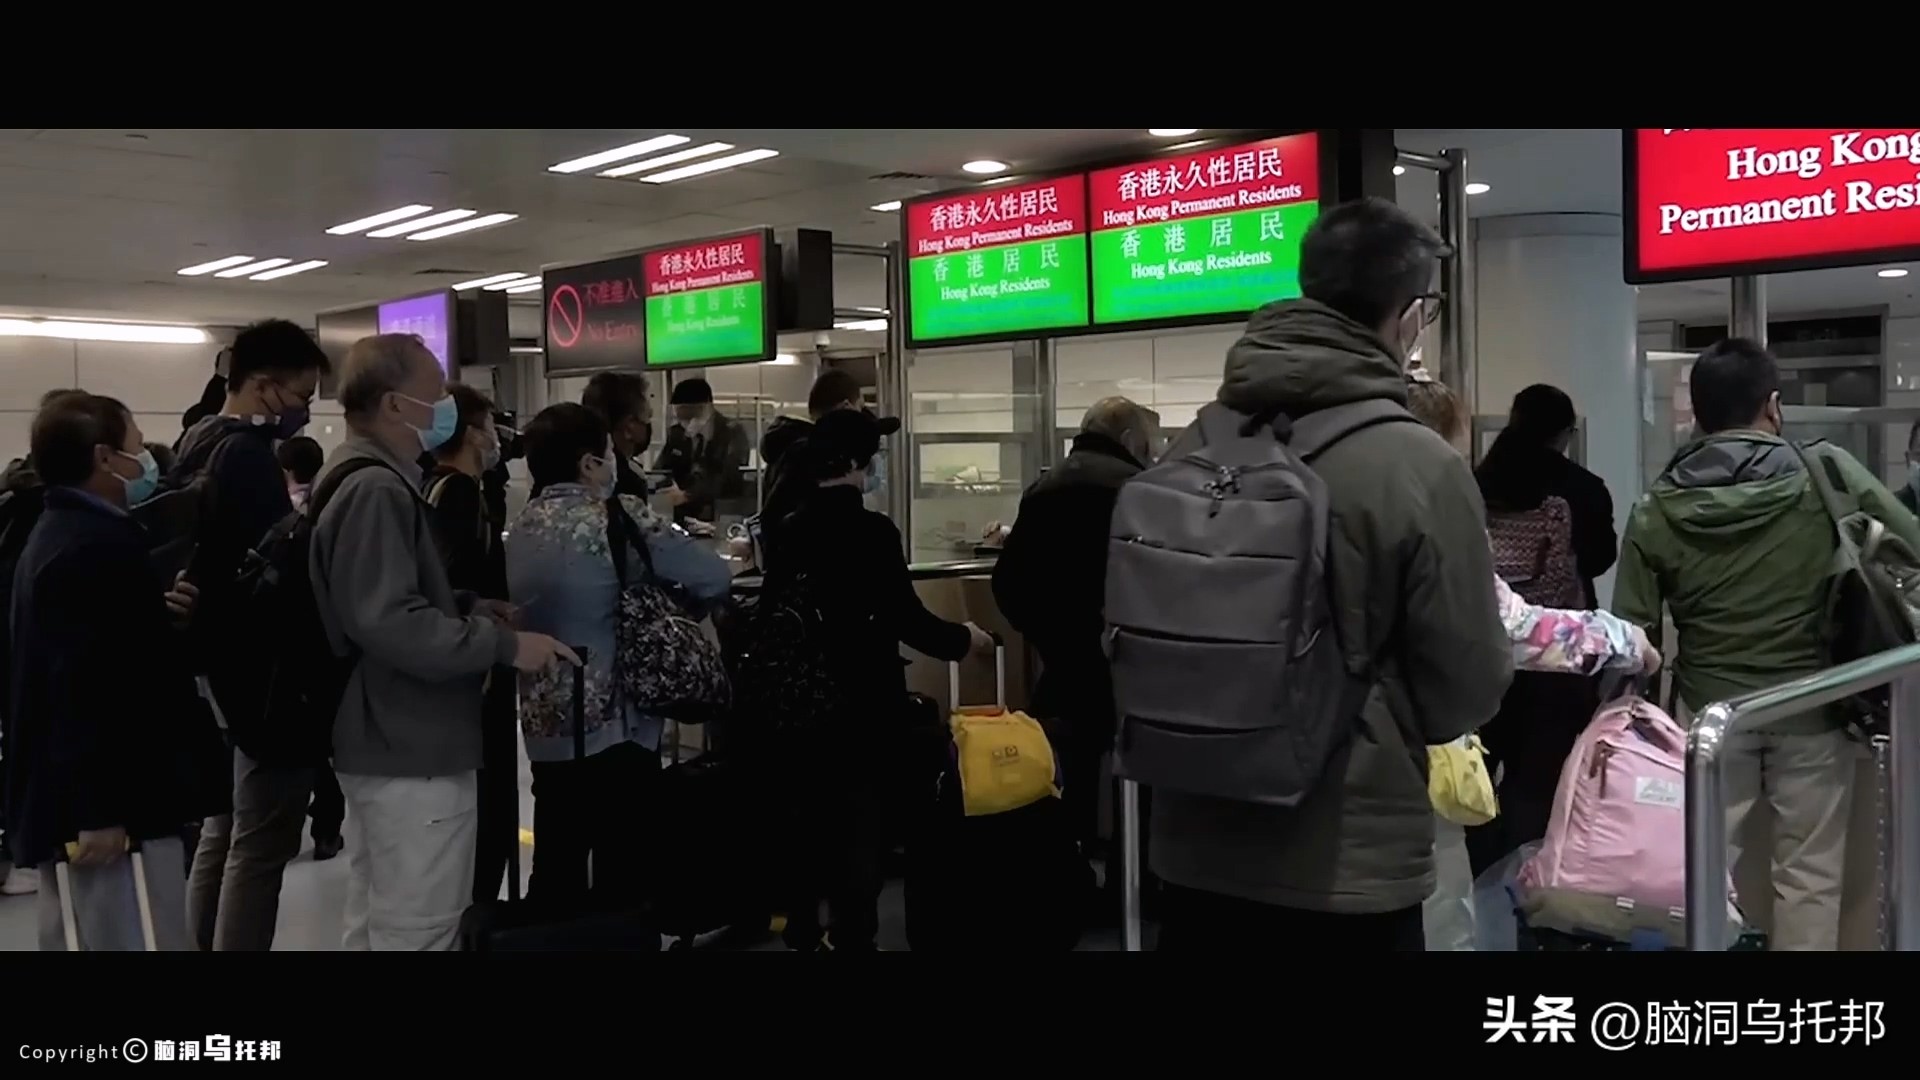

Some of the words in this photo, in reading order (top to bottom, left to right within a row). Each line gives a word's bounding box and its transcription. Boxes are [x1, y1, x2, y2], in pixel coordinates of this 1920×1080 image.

[1118, 147, 1283, 202] 香港永久性居民
[1727, 147, 1822, 180] Hong
[930, 187, 1058, 232] 香港永久性居民
[1103, 209, 1134, 226] Hong
[1136, 204, 1169, 221] Kong
[1171, 194, 1236, 216] Permanent
[1238, 183, 1302, 205] Residents
[1659, 187, 1837, 235] Permanent
[918, 238, 944, 254] Hong
[944, 235, 970, 250] Kong
[972, 227, 1023, 246] Permanent
[1024, 218, 1073, 237] Residents
[1120, 211, 1284, 259] 香港居民
[659, 242, 745, 277] 香港永久性居民
[1130, 261, 1166, 280] Hong
[1167, 257, 1203, 276] Kong
[1206, 249, 1272, 270] Residents
[941, 286, 968, 302] Hong
[970, 283, 998, 299] Kong
[1000, 276, 1051, 294] Residents
